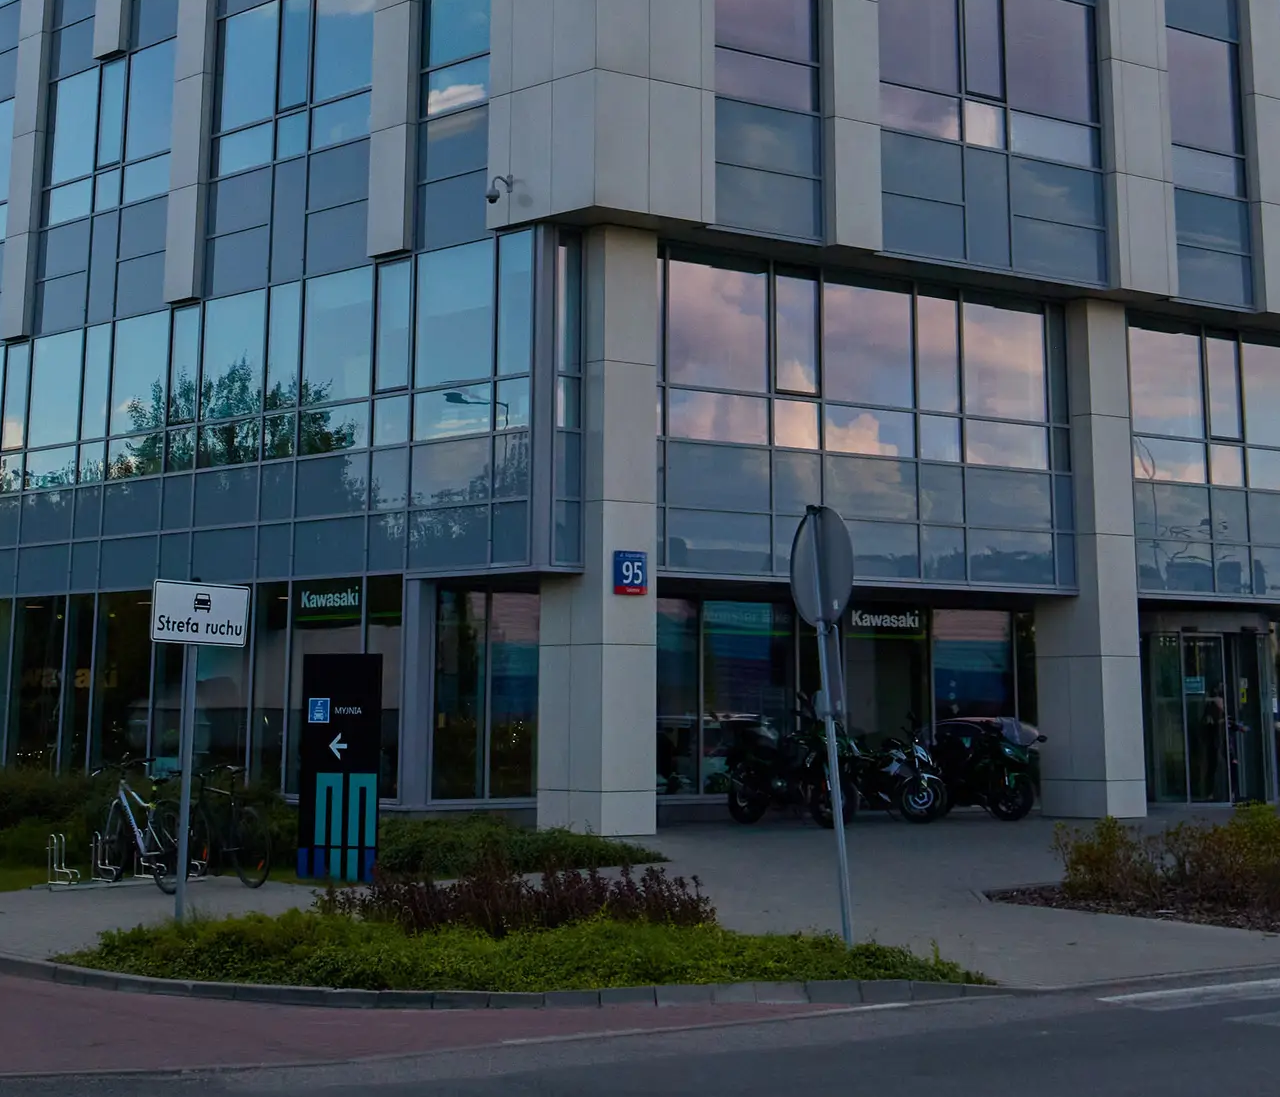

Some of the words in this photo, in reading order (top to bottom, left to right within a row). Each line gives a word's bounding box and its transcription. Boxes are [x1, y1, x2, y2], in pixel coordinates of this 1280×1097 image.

[622, 560, 643, 585] 95
[300, 585, 360, 609] Kawasaki
[157, 614, 199, 633] Strefa
[205, 619, 243, 637] ruchu
[850, 609, 920, 630] Kawasaki
[333, 706, 363, 715] MYJNIA
